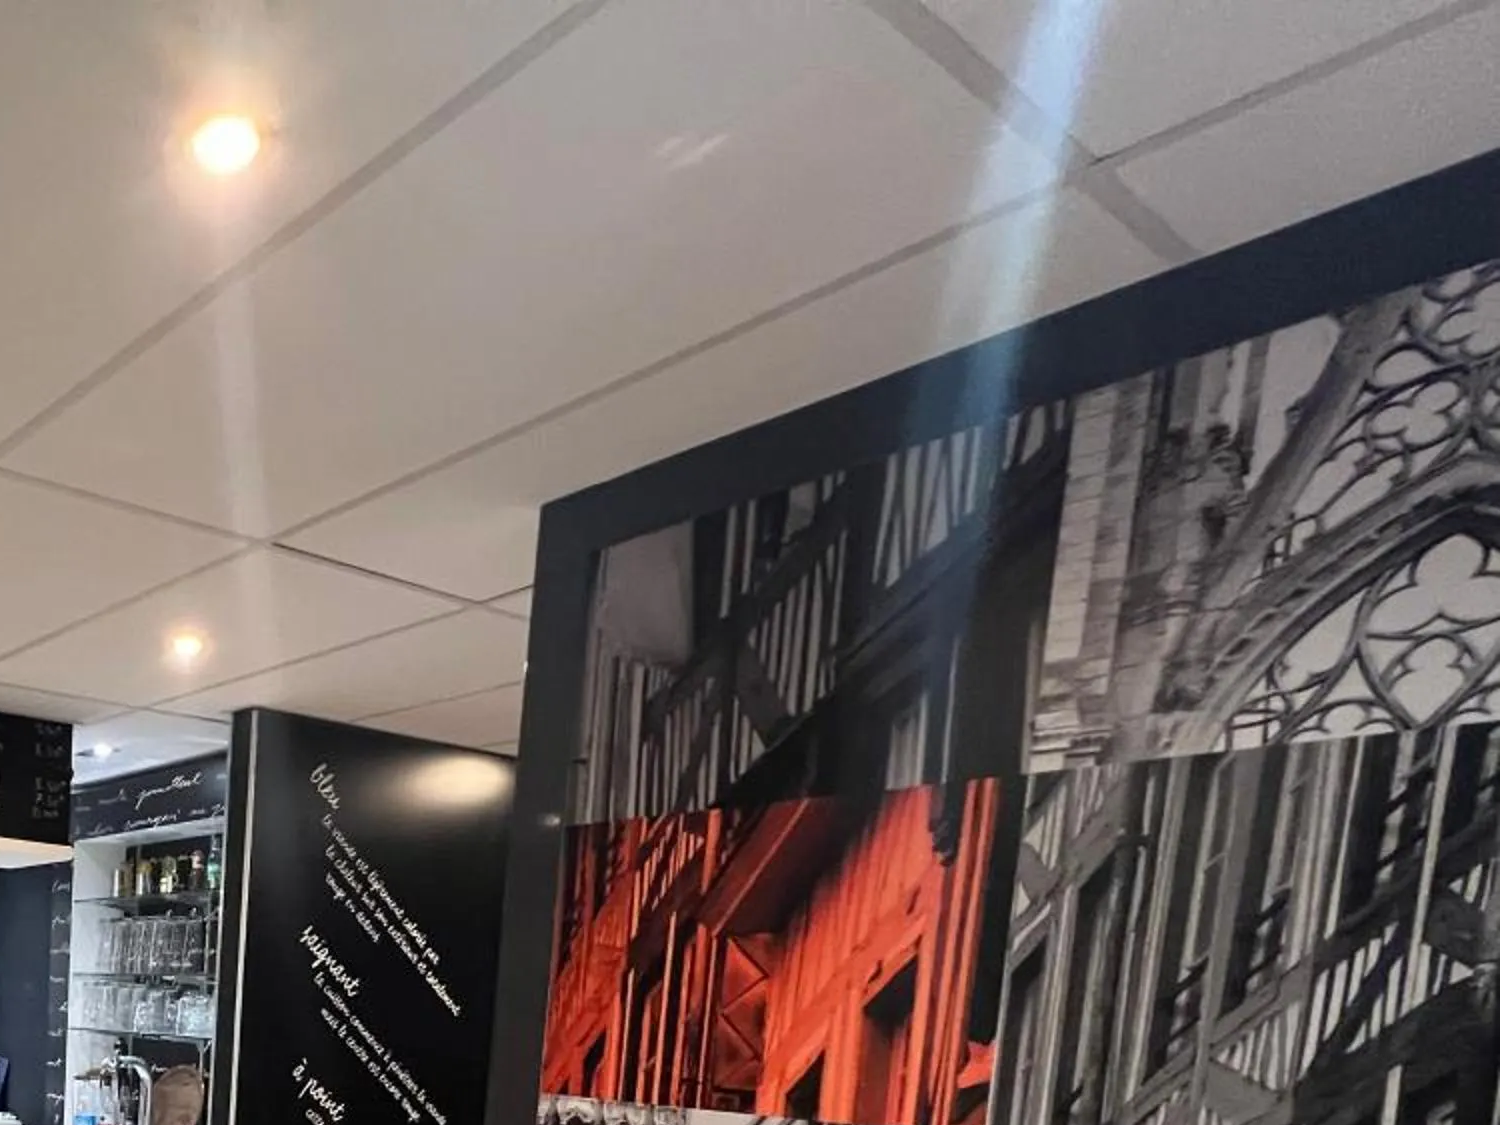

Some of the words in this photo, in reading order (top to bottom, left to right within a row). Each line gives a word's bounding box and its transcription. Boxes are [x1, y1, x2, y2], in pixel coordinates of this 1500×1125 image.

[310, 764, 340, 810] bleu
[300, 925, 359, 1002] saignant
[292, 1058, 307, 1081] à
